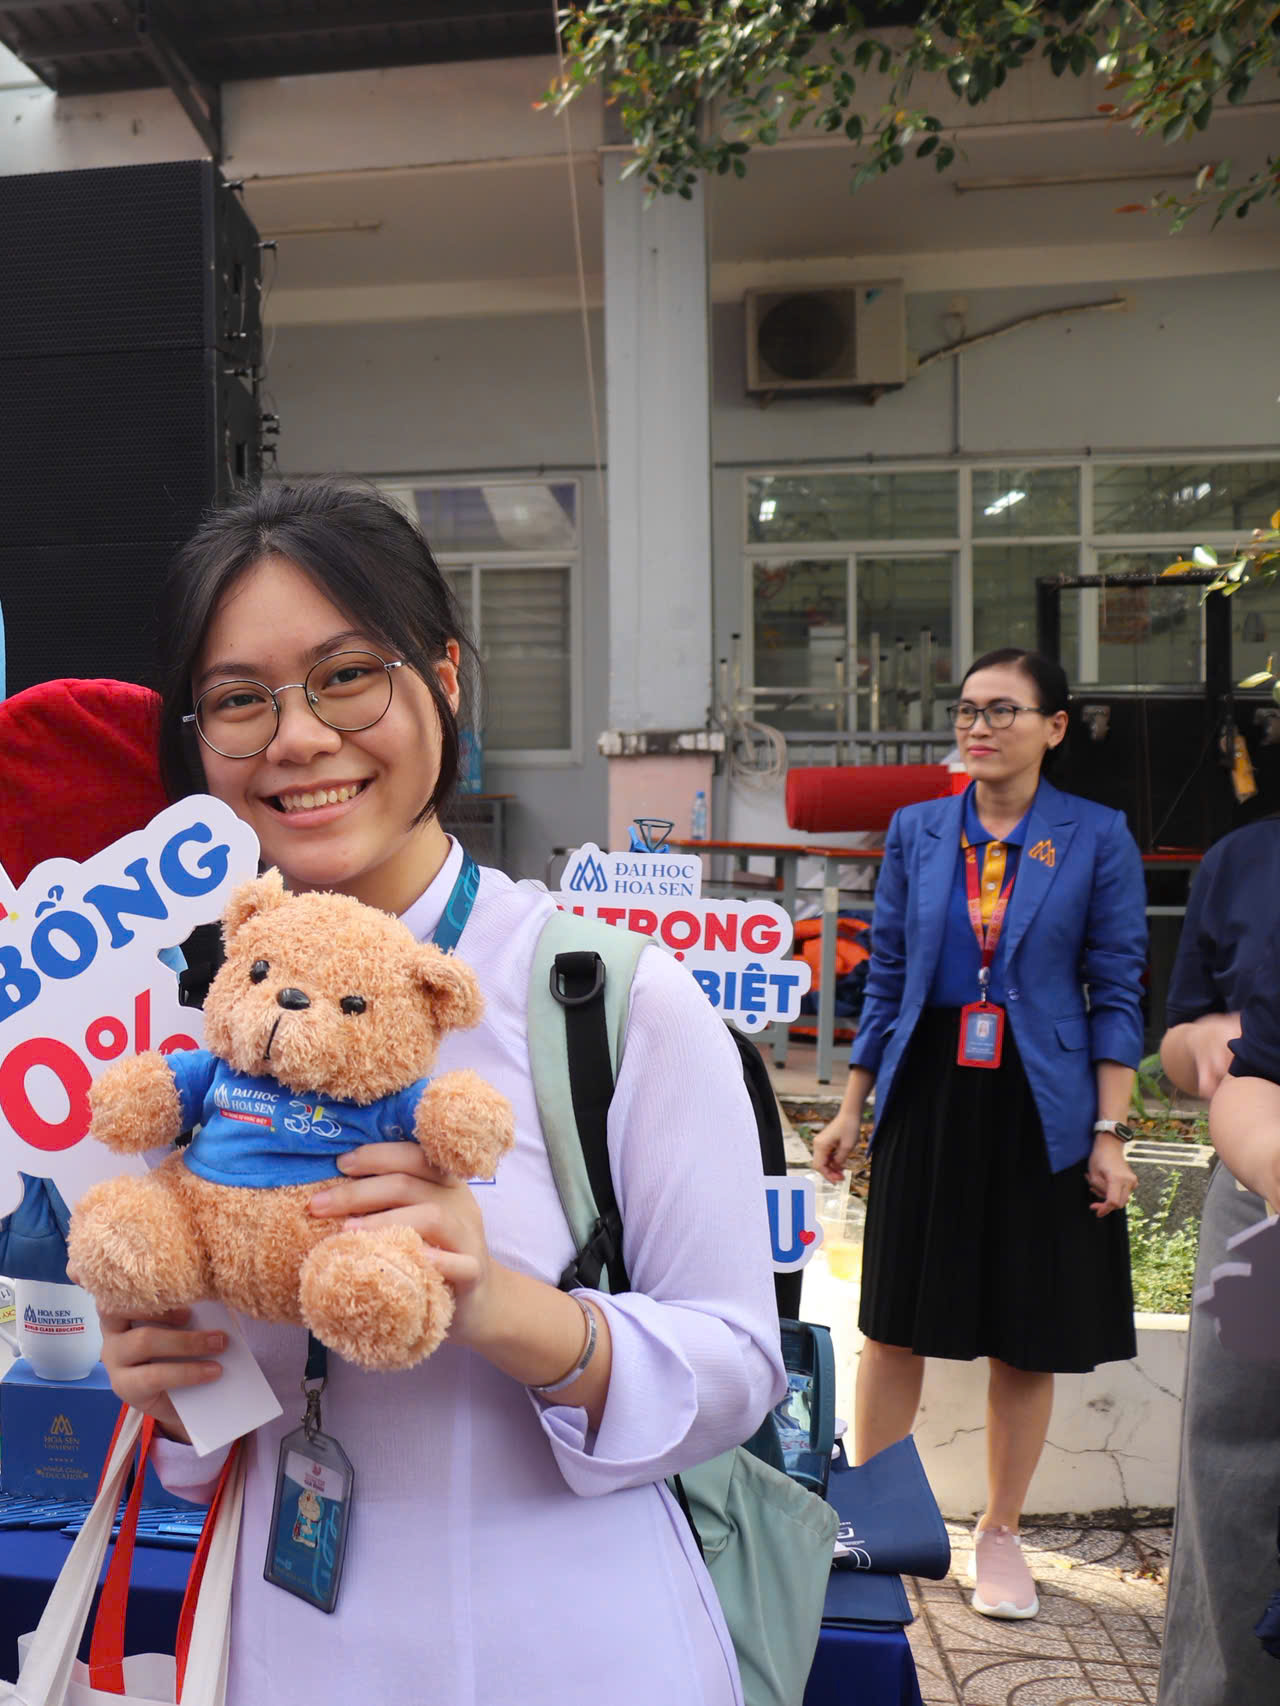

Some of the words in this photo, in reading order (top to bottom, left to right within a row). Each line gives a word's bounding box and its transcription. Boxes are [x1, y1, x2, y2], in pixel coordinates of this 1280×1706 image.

[614, 880, 655, 895] HOA
[658, 882, 694, 897] SEN
[231, 1100, 252, 1112] HOA
[254, 1102, 276, 1115] SEN
[1, 1289, 11, 1298] 11
[38, 1309, 53, 1317] HOA
[37, 1317, 84, 1325] UNIVERSITY
